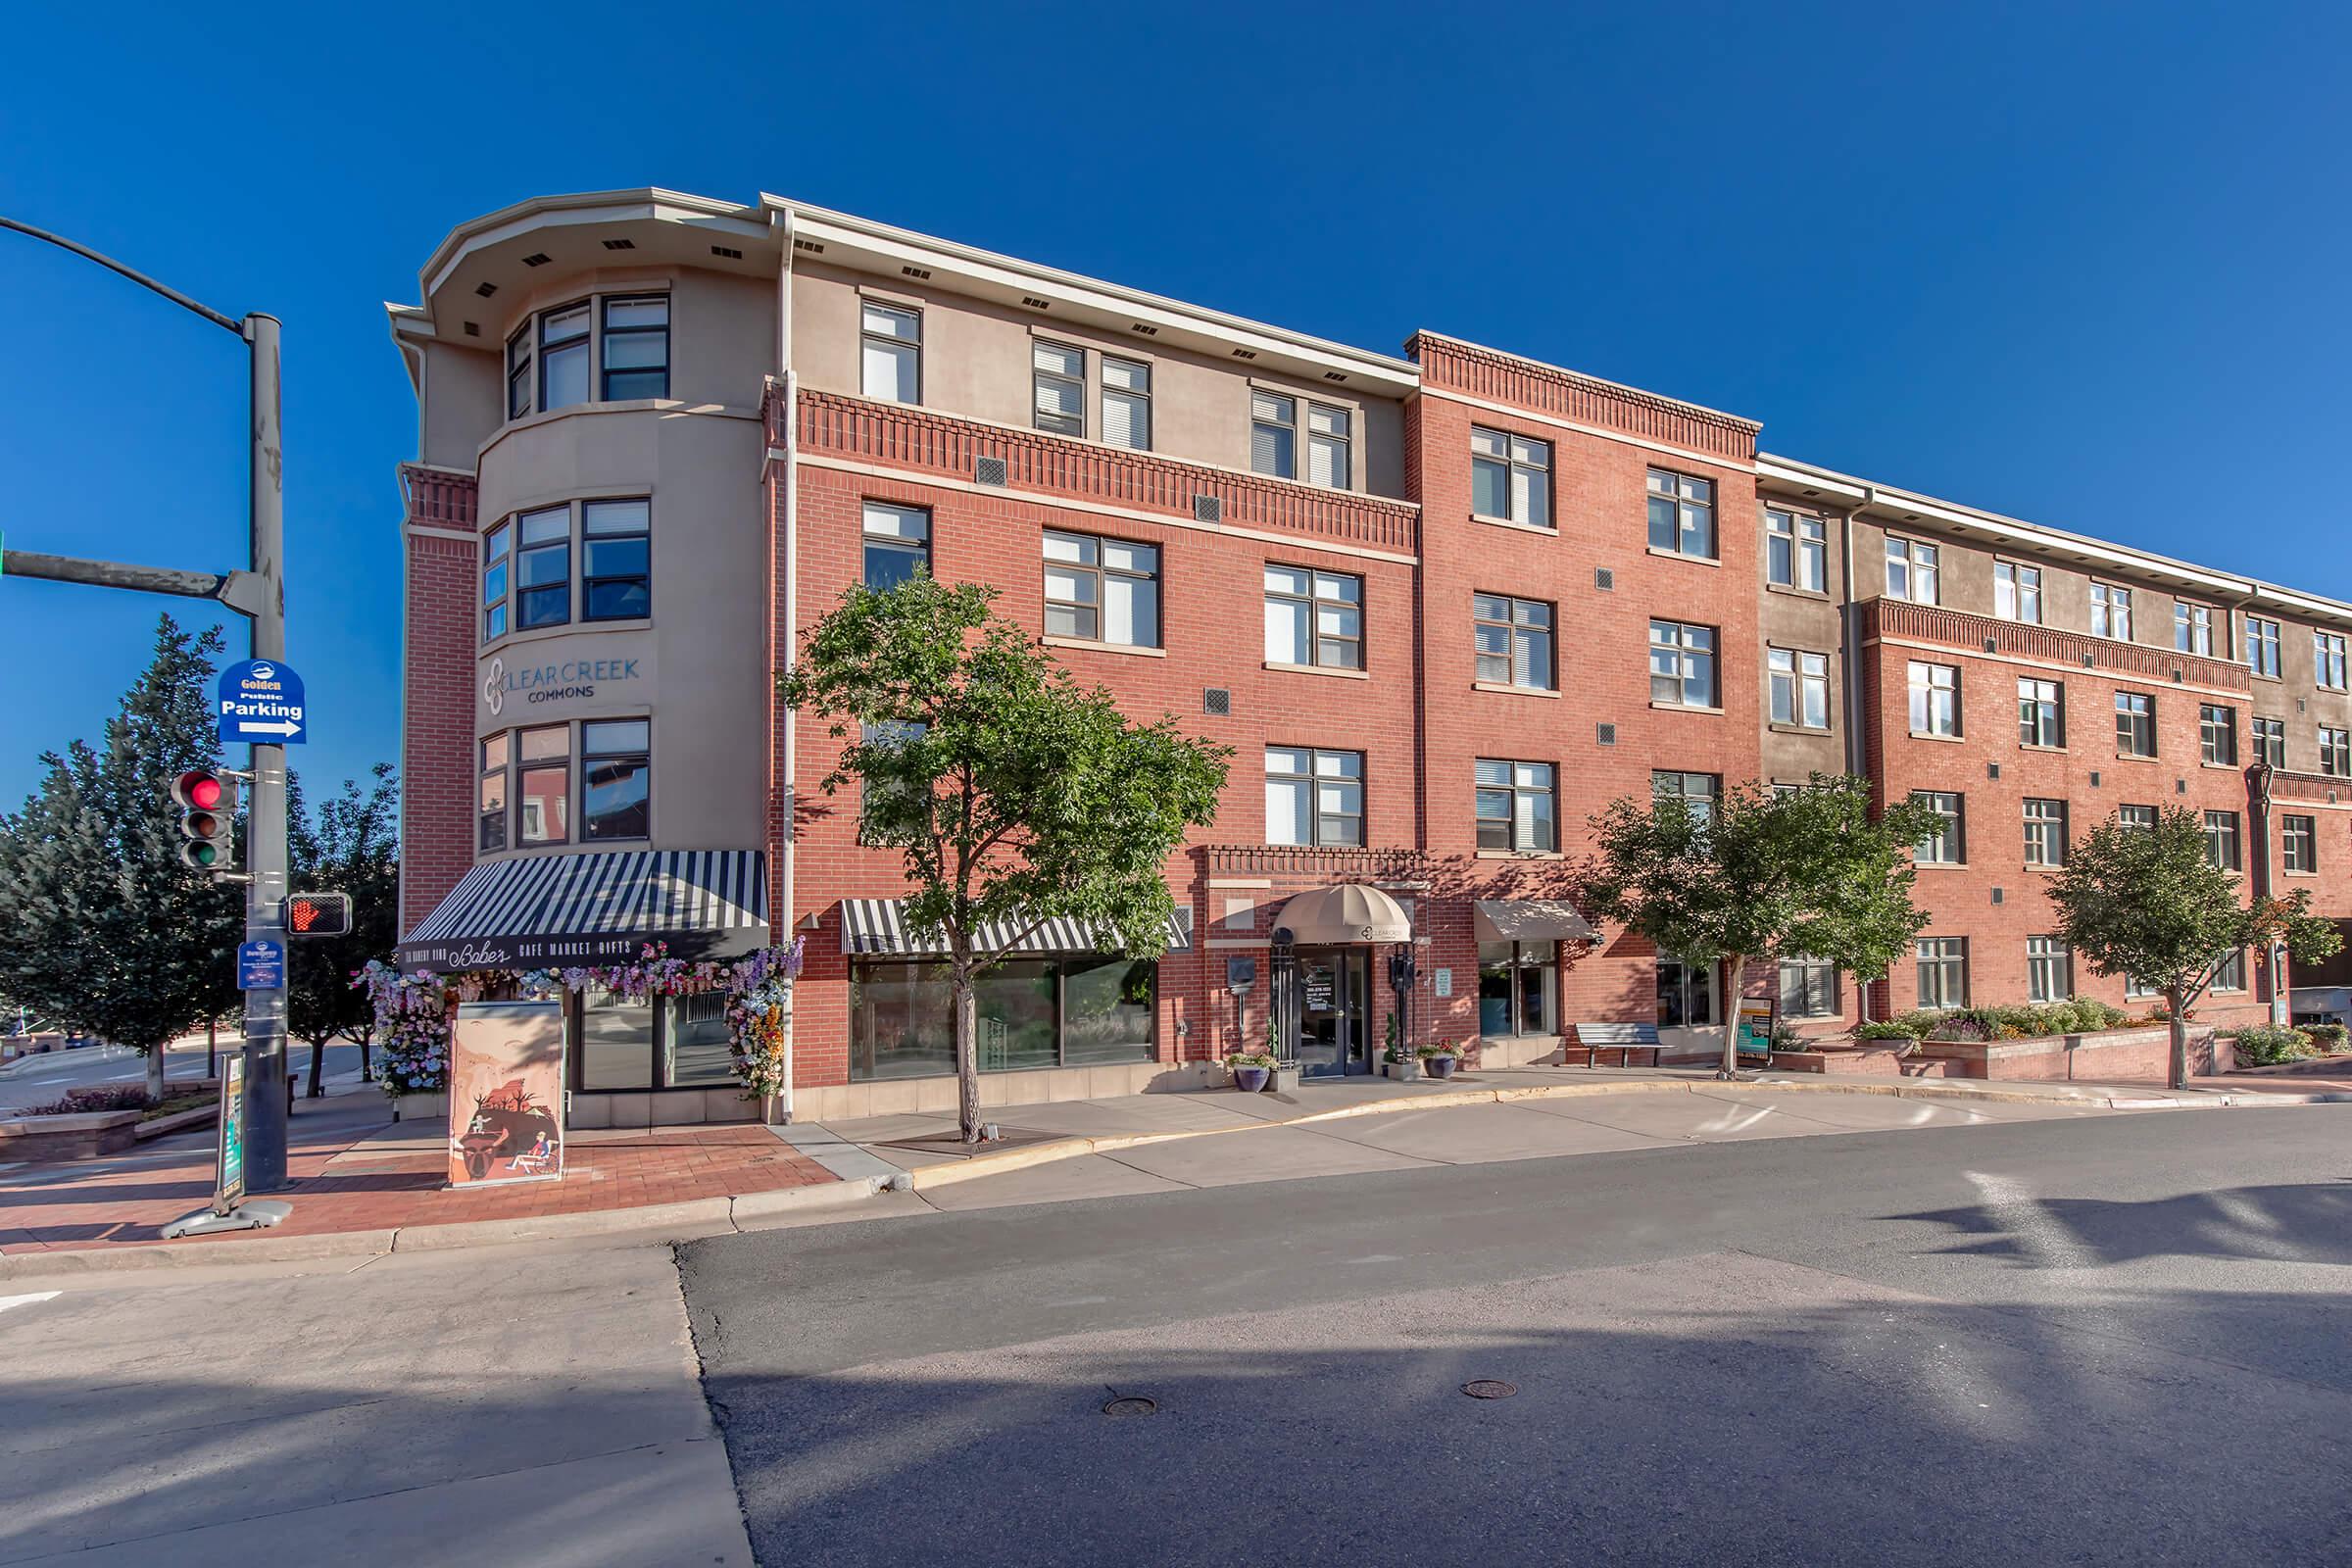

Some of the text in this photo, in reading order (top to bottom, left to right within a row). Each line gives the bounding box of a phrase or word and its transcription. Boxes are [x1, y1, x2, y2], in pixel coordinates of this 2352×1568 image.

[241, 679, 281, 690] Golden
[501, 659, 639, 692] CLEAR CREEK
[528, 686, 594, 704] COMMONS
[221, 701, 302, 720] Parking
[449, 940, 512, 967] Babe's
[549, 942, 590, 956] MARKET
[599, 940, 631, 955] GIFTS
